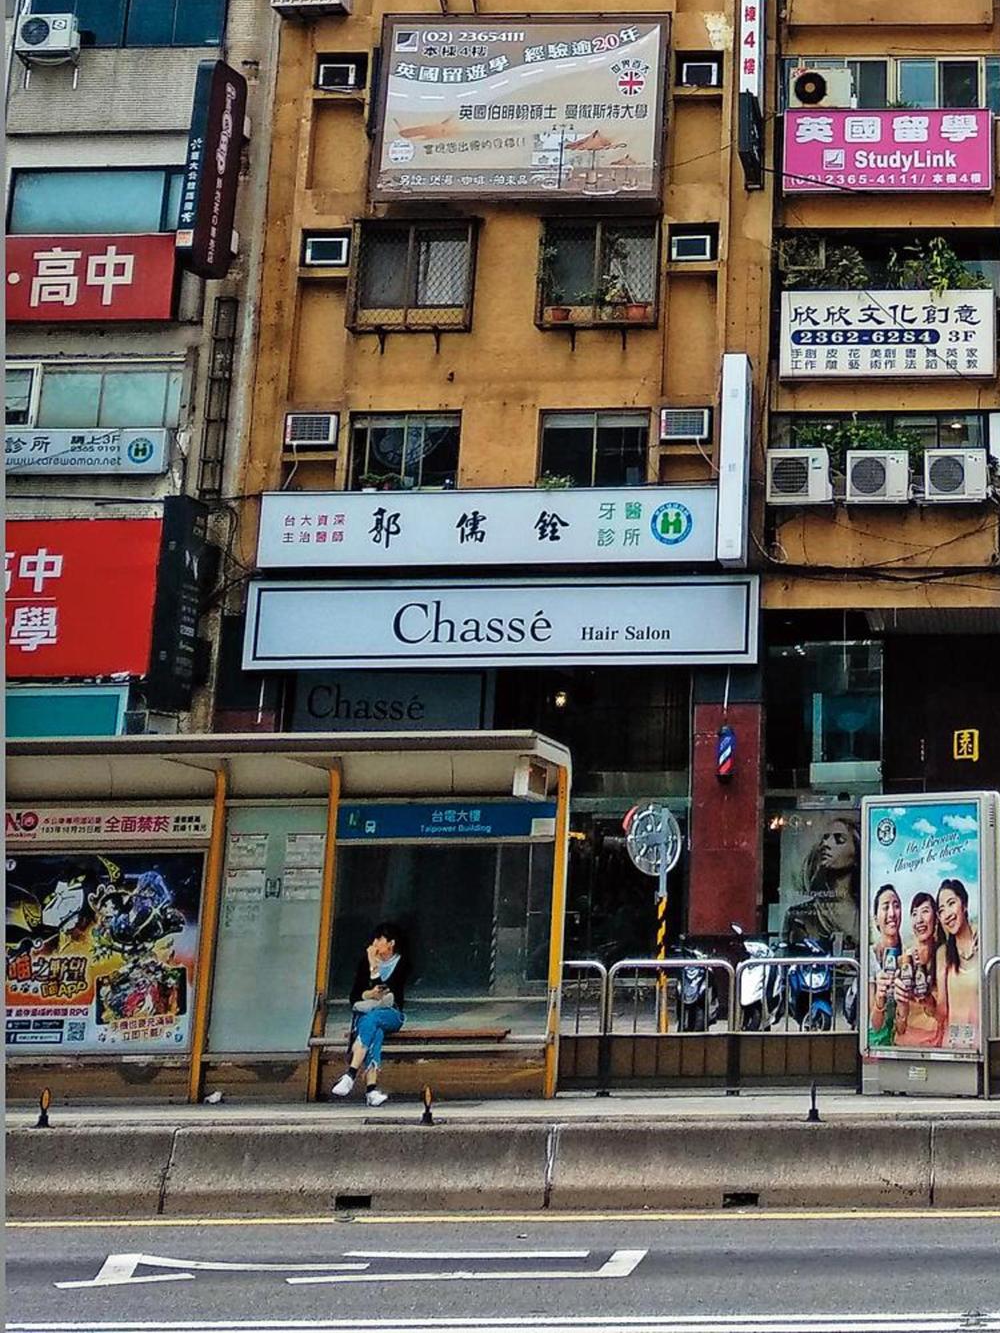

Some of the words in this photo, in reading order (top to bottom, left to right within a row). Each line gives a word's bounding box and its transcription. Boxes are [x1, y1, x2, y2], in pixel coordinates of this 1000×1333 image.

[795, 114, 979, 143] 英國留學
[854, 150, 958, 172] StudyLink
[30, 245, 135, 307] 高中
[790, 304, 982, 326] 欣欣文化創意
[800, 330, 932, 344] 2362-6284
[948, 330, 977, 343] 3F
[597, 528, 641, 547] 診所
[392, 599, 553, 645] Chassé
[581, 626, 620, 641] Hair
[625, 625, 672, 641] Salon
[307, 684, 425, 722] Chassé
[104, 815, 170, 834] 全面禁菸
[431, 809, 481, 823] 台電大樓
